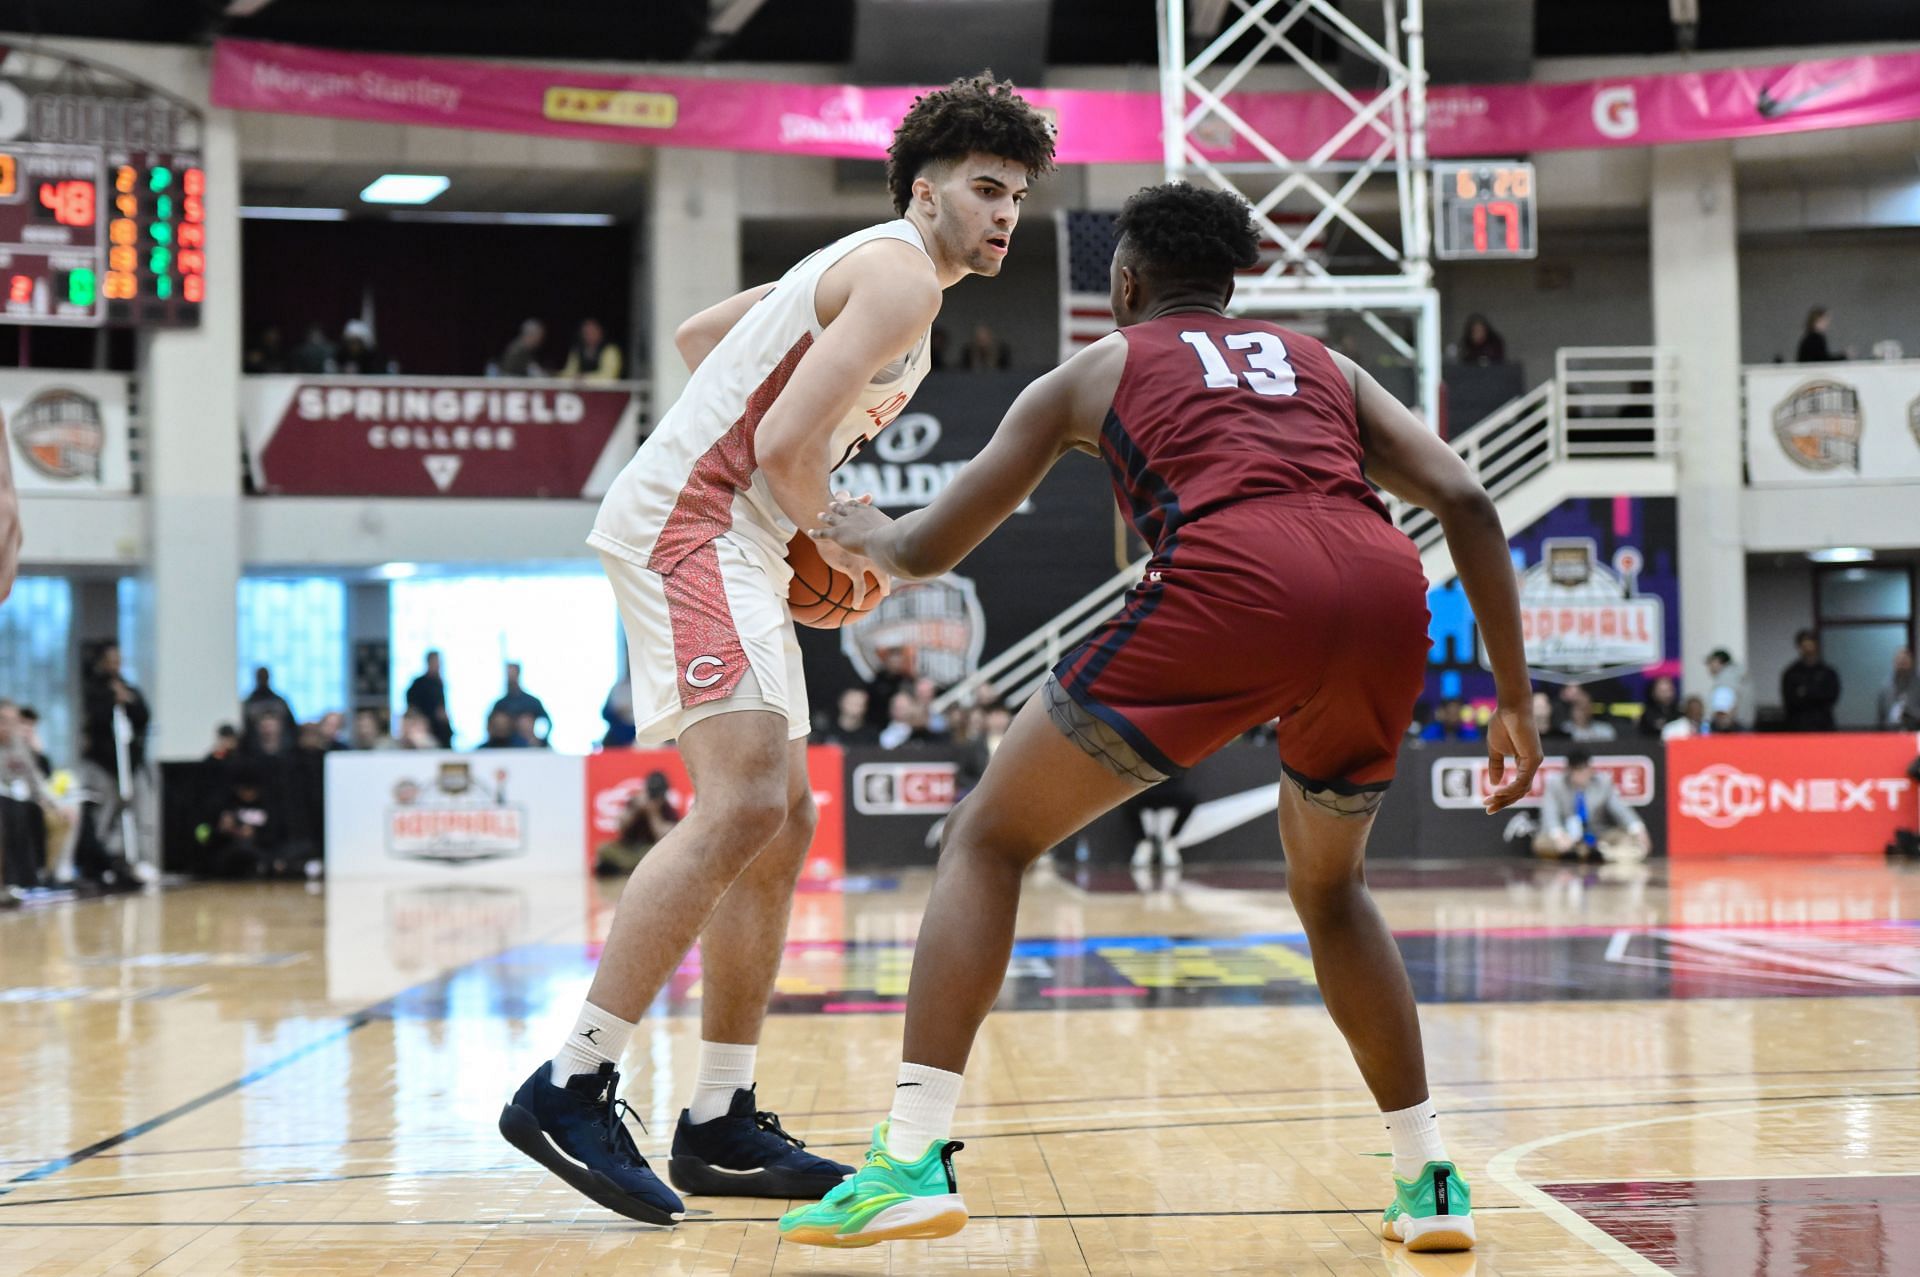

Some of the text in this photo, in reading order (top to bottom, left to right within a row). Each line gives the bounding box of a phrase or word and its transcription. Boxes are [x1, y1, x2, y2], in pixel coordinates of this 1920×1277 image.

[1592, 87, 1640, 138] G
[39, 180, 95, 227] 48
[1473, 200, 1519, 253] 17
[1178, 331, 1298, 397] 13
[298, 387, 585, 424] SPRINGFIELD
[367, 425, 515, 450] COLLEGE
[685, 654, 725, 689] C
[1768, 778, 1911, 812] NEXT
